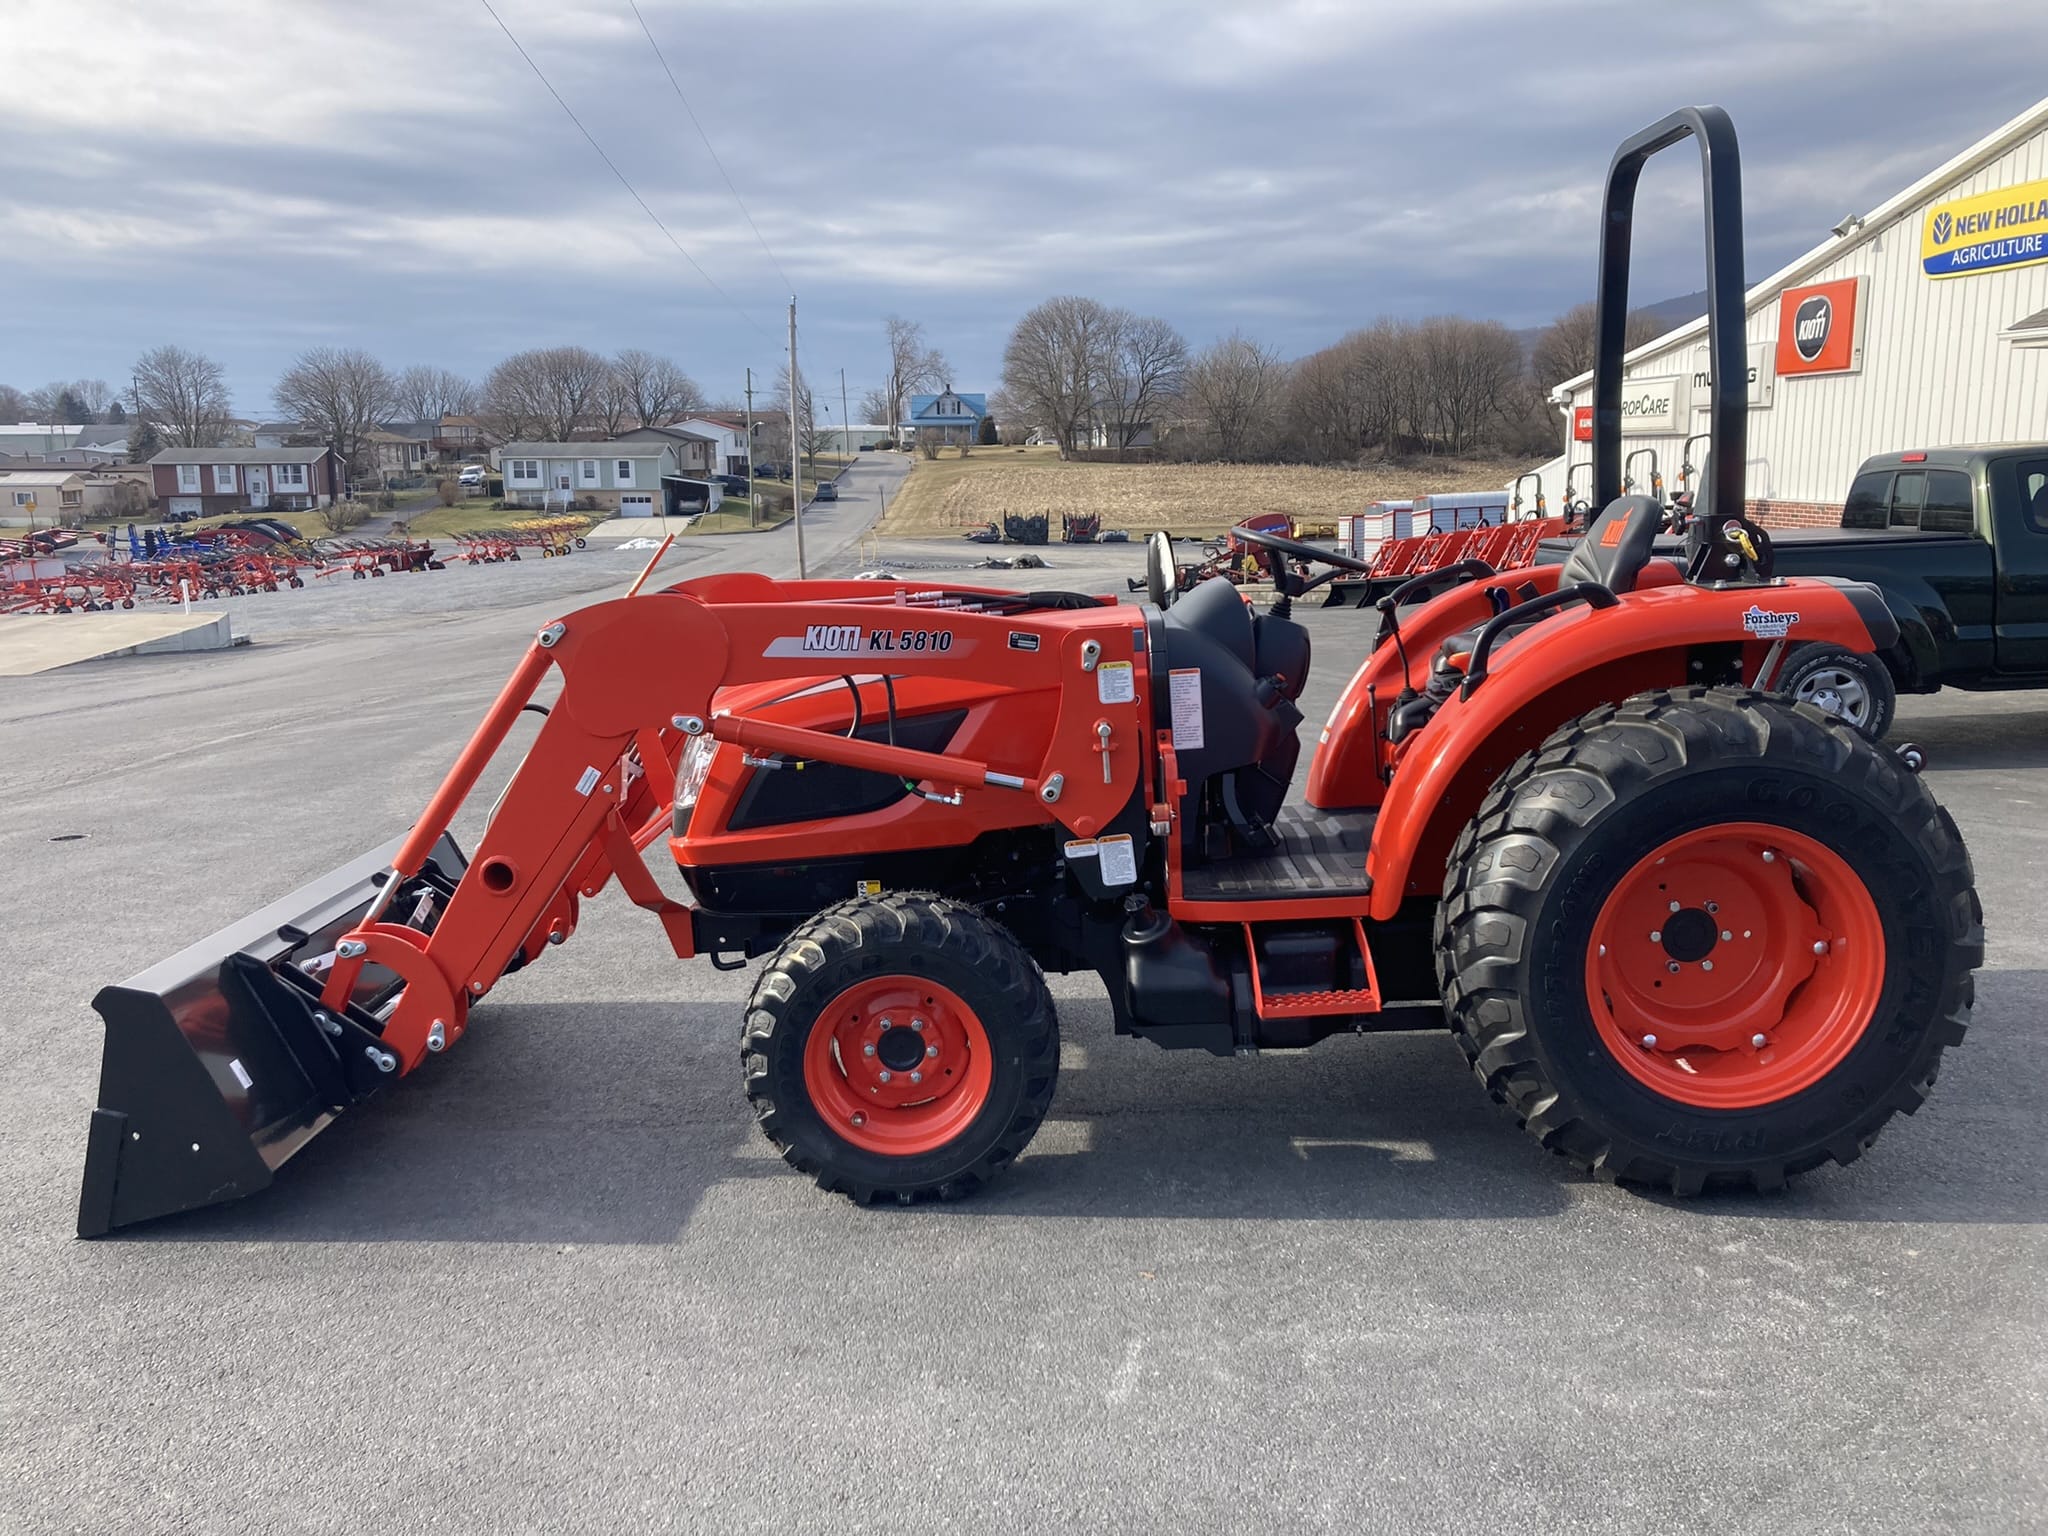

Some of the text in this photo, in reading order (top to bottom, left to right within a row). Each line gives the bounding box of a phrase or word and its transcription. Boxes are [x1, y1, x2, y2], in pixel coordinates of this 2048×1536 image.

[1955, 210, 1993, 237] NEW
[1951, 234, 2043, 266] AGRICULTURE
[1622, 394, 1670, 416] ROPCARE
[1744, 612, 1799, 625] Forsheys
[804, 625, 862, 651] KIOTI
[900, 631, 952, 651] 5810
